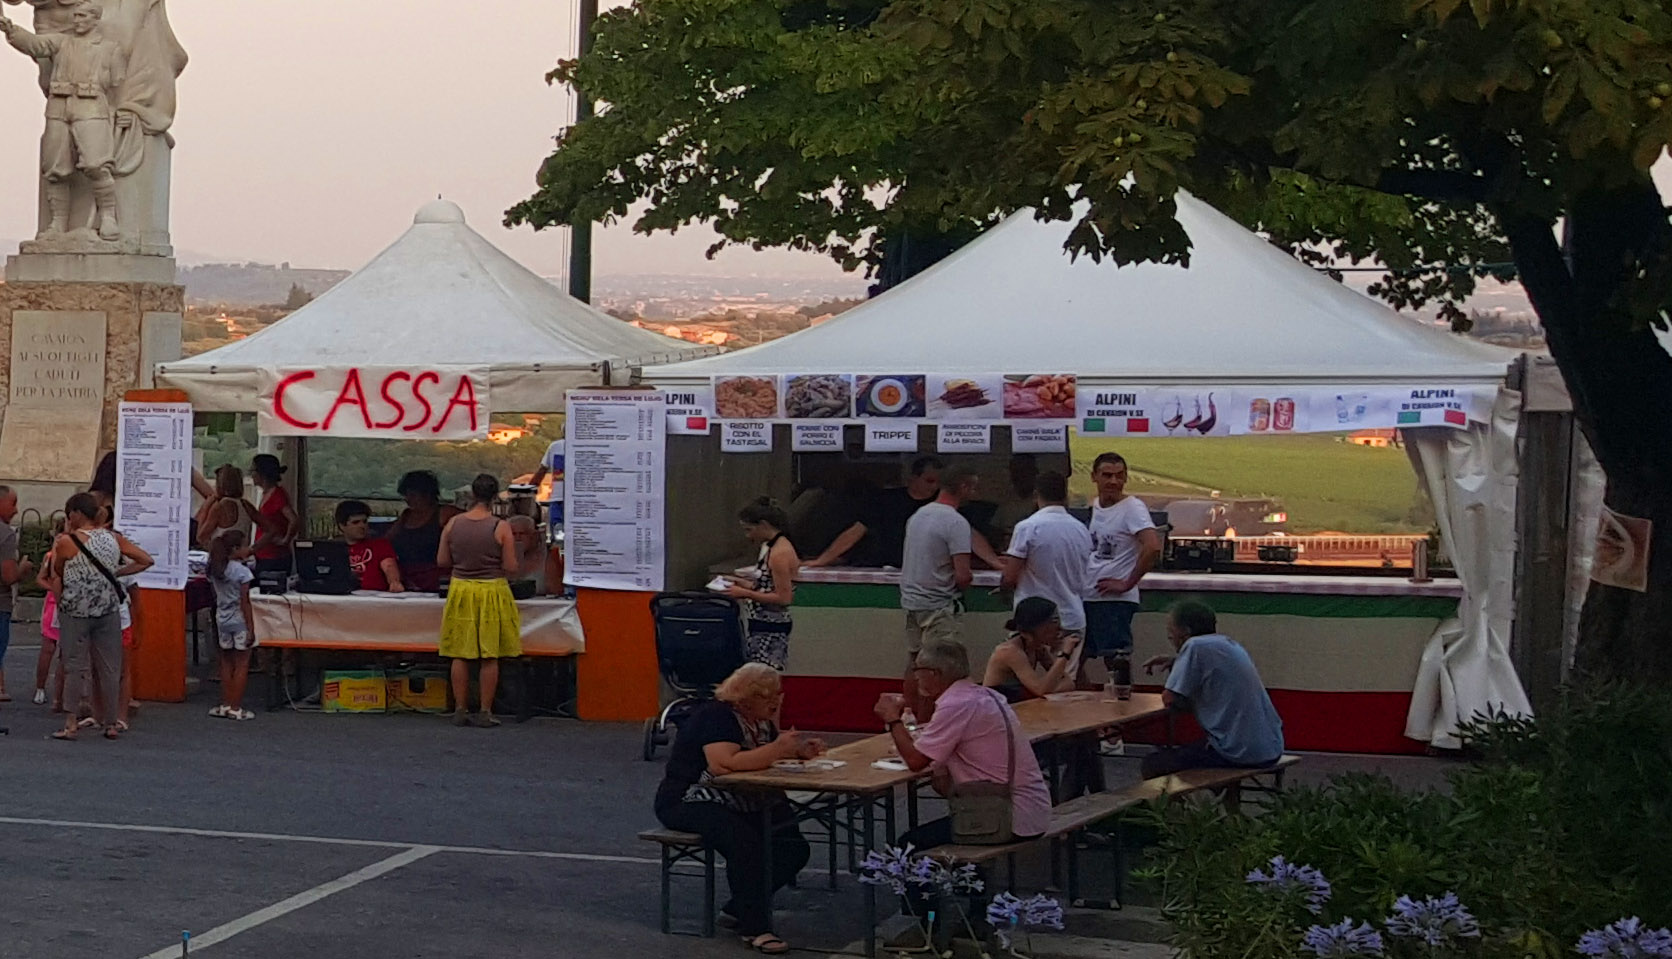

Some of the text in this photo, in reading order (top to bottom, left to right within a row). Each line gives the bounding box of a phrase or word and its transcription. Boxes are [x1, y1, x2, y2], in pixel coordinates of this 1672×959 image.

[273, 368, 478, 432] CASSA
[665, 393, 695, 405] LPINI
[1095, 393, 1137, 406] ALPINI
[1410, 389, 1455, 399] ALPINI
[872, 431, 912, 440] TRIPPE
